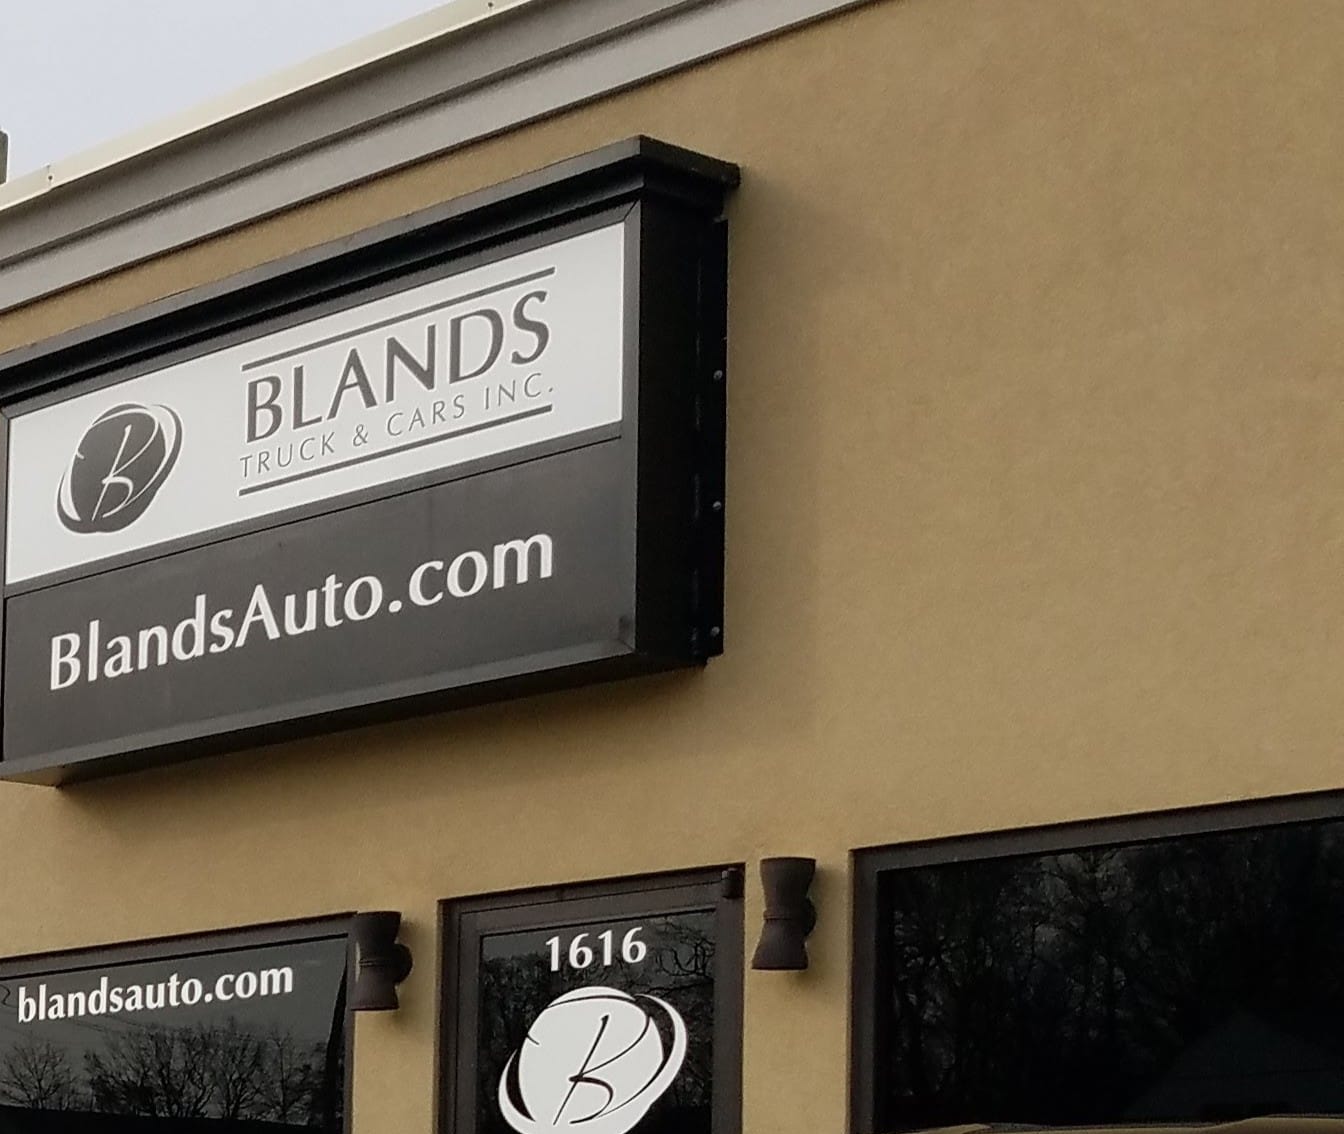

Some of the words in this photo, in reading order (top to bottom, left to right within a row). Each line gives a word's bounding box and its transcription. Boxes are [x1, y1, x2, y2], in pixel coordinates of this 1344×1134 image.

[245, 289, 551, 444] BLANDS
[239, 431, 336, 479] TRUCK
[352, 423, 369, 447] &
[387, 400, 466, 438] CARS
[483, 371, 555, 411] INC.
[50, 532, 554, 691] BlandsAuto.com
[18, 966, 294, 1023] blandsauto.com
[545, 926, 647, 972] 1616
